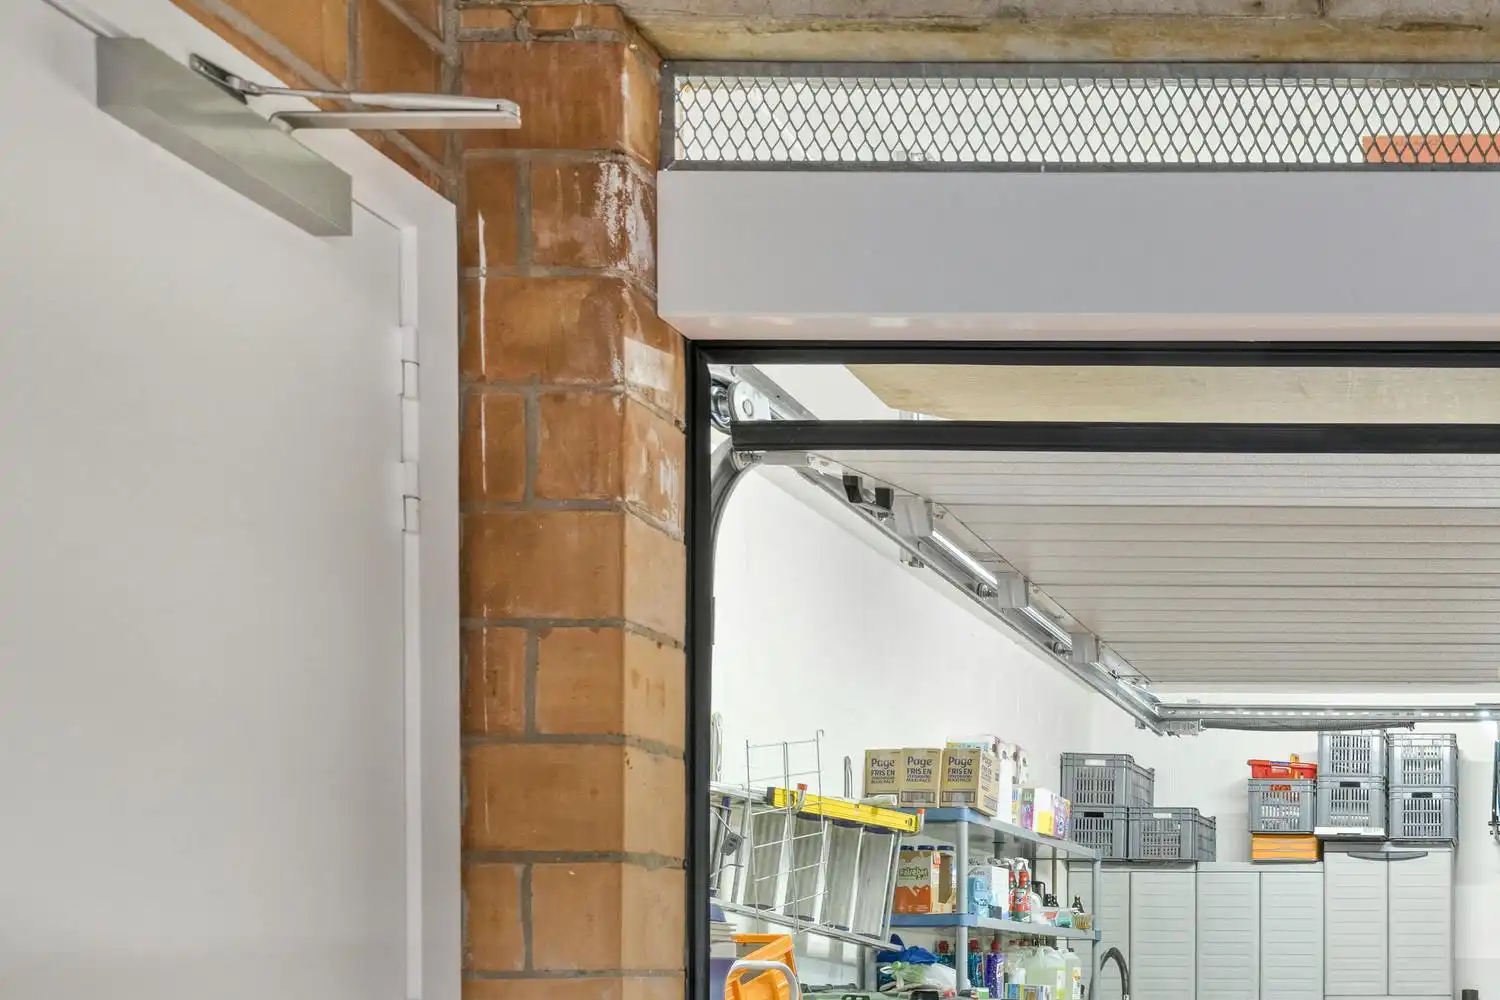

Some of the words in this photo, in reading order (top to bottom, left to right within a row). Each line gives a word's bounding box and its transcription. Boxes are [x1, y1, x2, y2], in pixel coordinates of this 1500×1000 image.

[871, 758, 895, 771] Page
[907, 756, 933, 769] Page
[948, 756, 973, 769] Page
